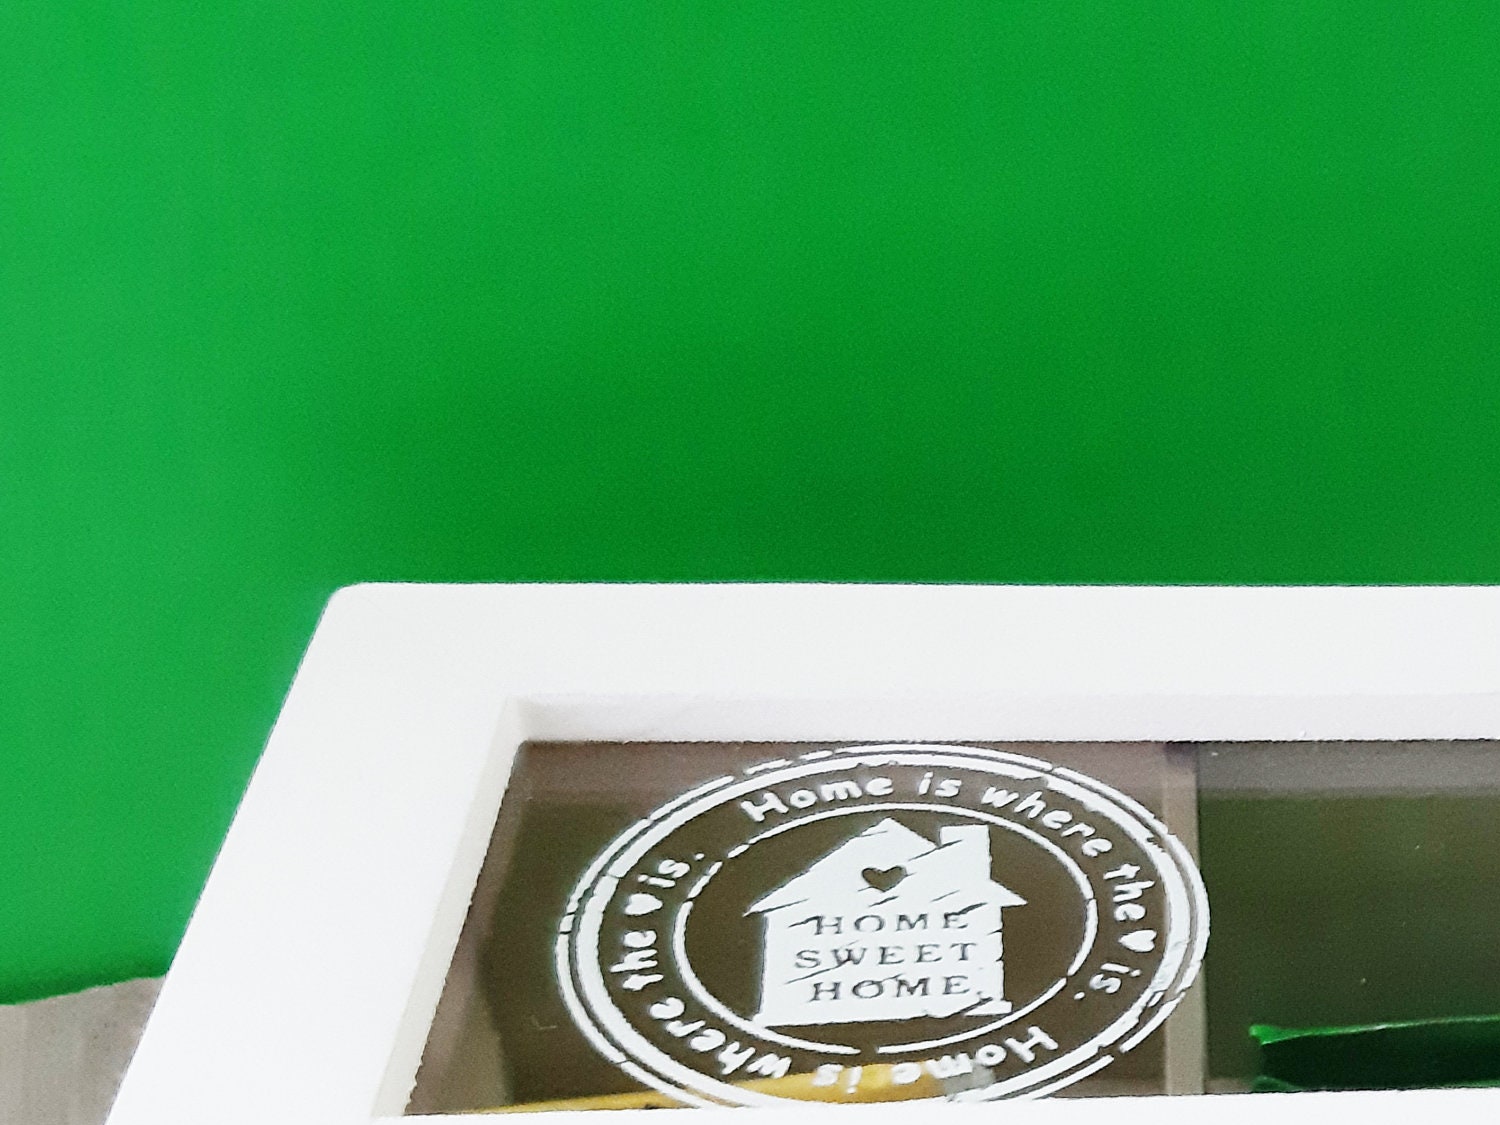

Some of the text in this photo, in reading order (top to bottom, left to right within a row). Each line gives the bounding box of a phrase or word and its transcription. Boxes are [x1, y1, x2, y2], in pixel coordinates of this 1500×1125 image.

[741, 776, 894, 822] Home
[917, 771, 963, 798] is
[980, 785, 1113, 857] where
[1102, 862, 1155, 922] the
[812, 912, 970, 936] HOME
[610, 928, 665, 992] the
[794, 941, 977, 969] SWEET
[809, 975, 970, 1003] HOME
[648, 996, 793, 1078] where
[891, 1025, 1059, 1085] Home
[812, 1063, 864, 1095] is
